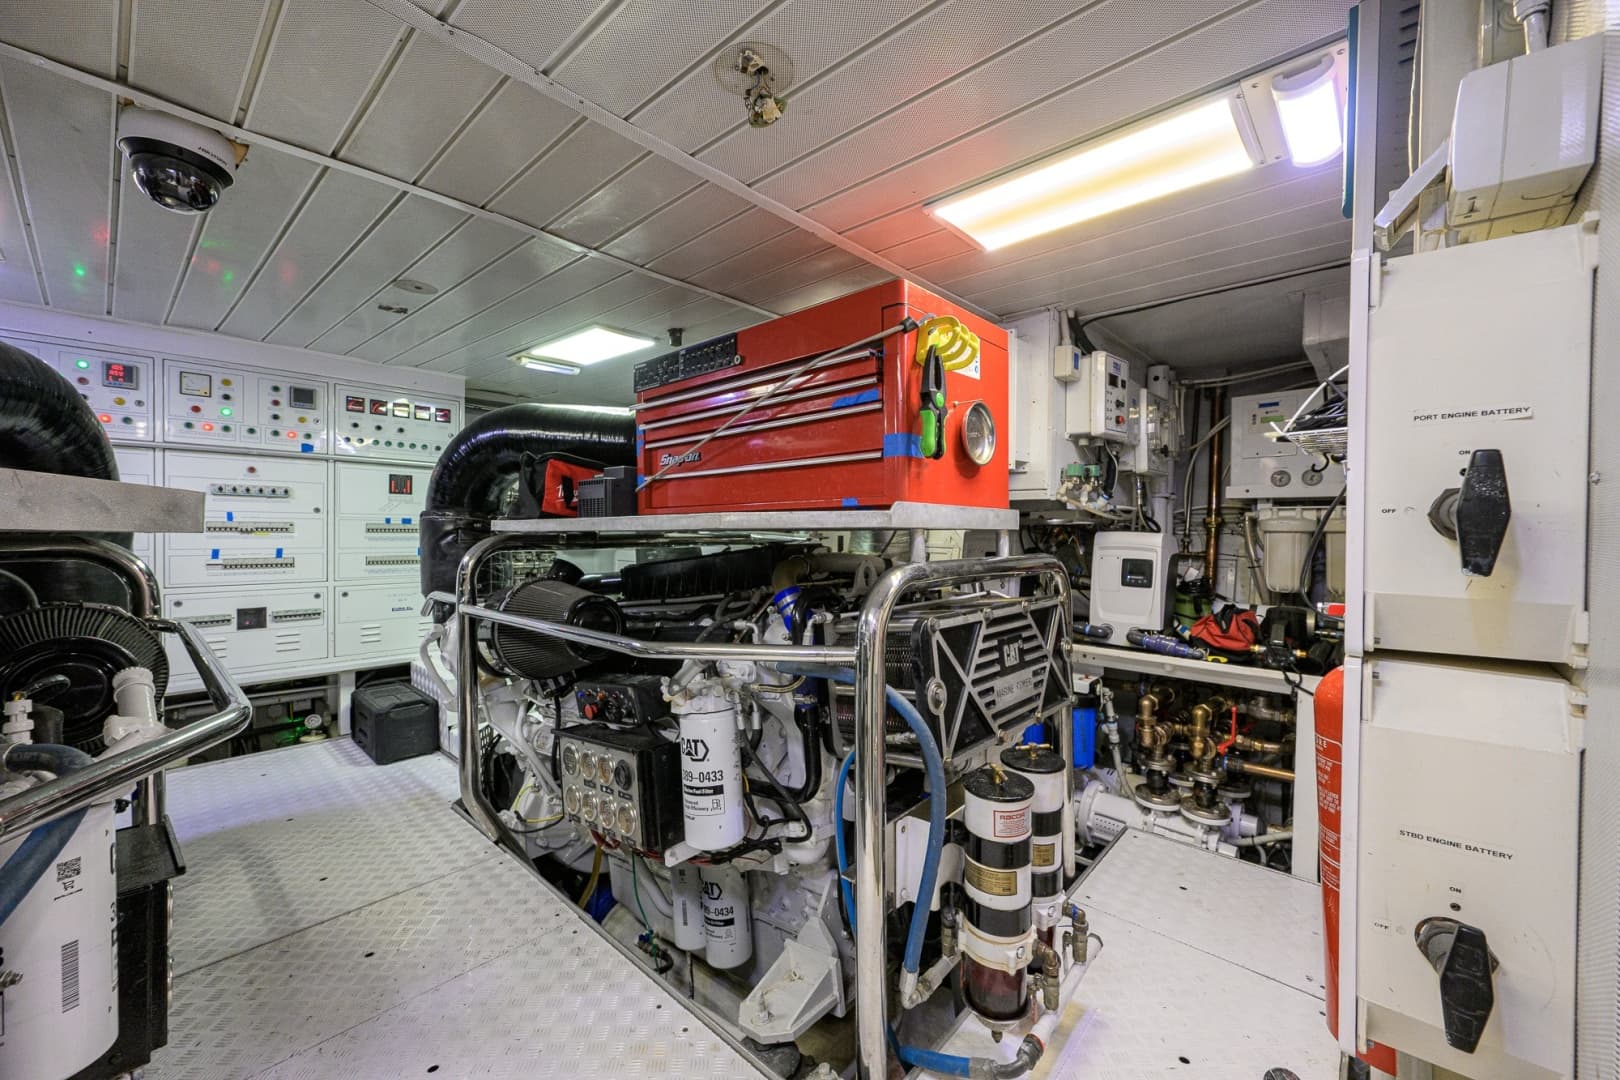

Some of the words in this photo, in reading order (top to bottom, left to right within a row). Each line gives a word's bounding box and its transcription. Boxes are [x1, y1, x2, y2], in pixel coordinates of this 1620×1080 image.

[1441, 411, 1478, 420] ENGINE
[1481, 406, 1531, 417] BATTERY
[1003, 641, 1020, 667] CAT
[681, 737, 701, 758] CAT
[1399, 829, 1424, 840] STBD
[1426, 836, 1462, 849] ENGINE
[1464, 844, 1513, 860] BATTERY
[1449, 886, 1462, 894] ON
